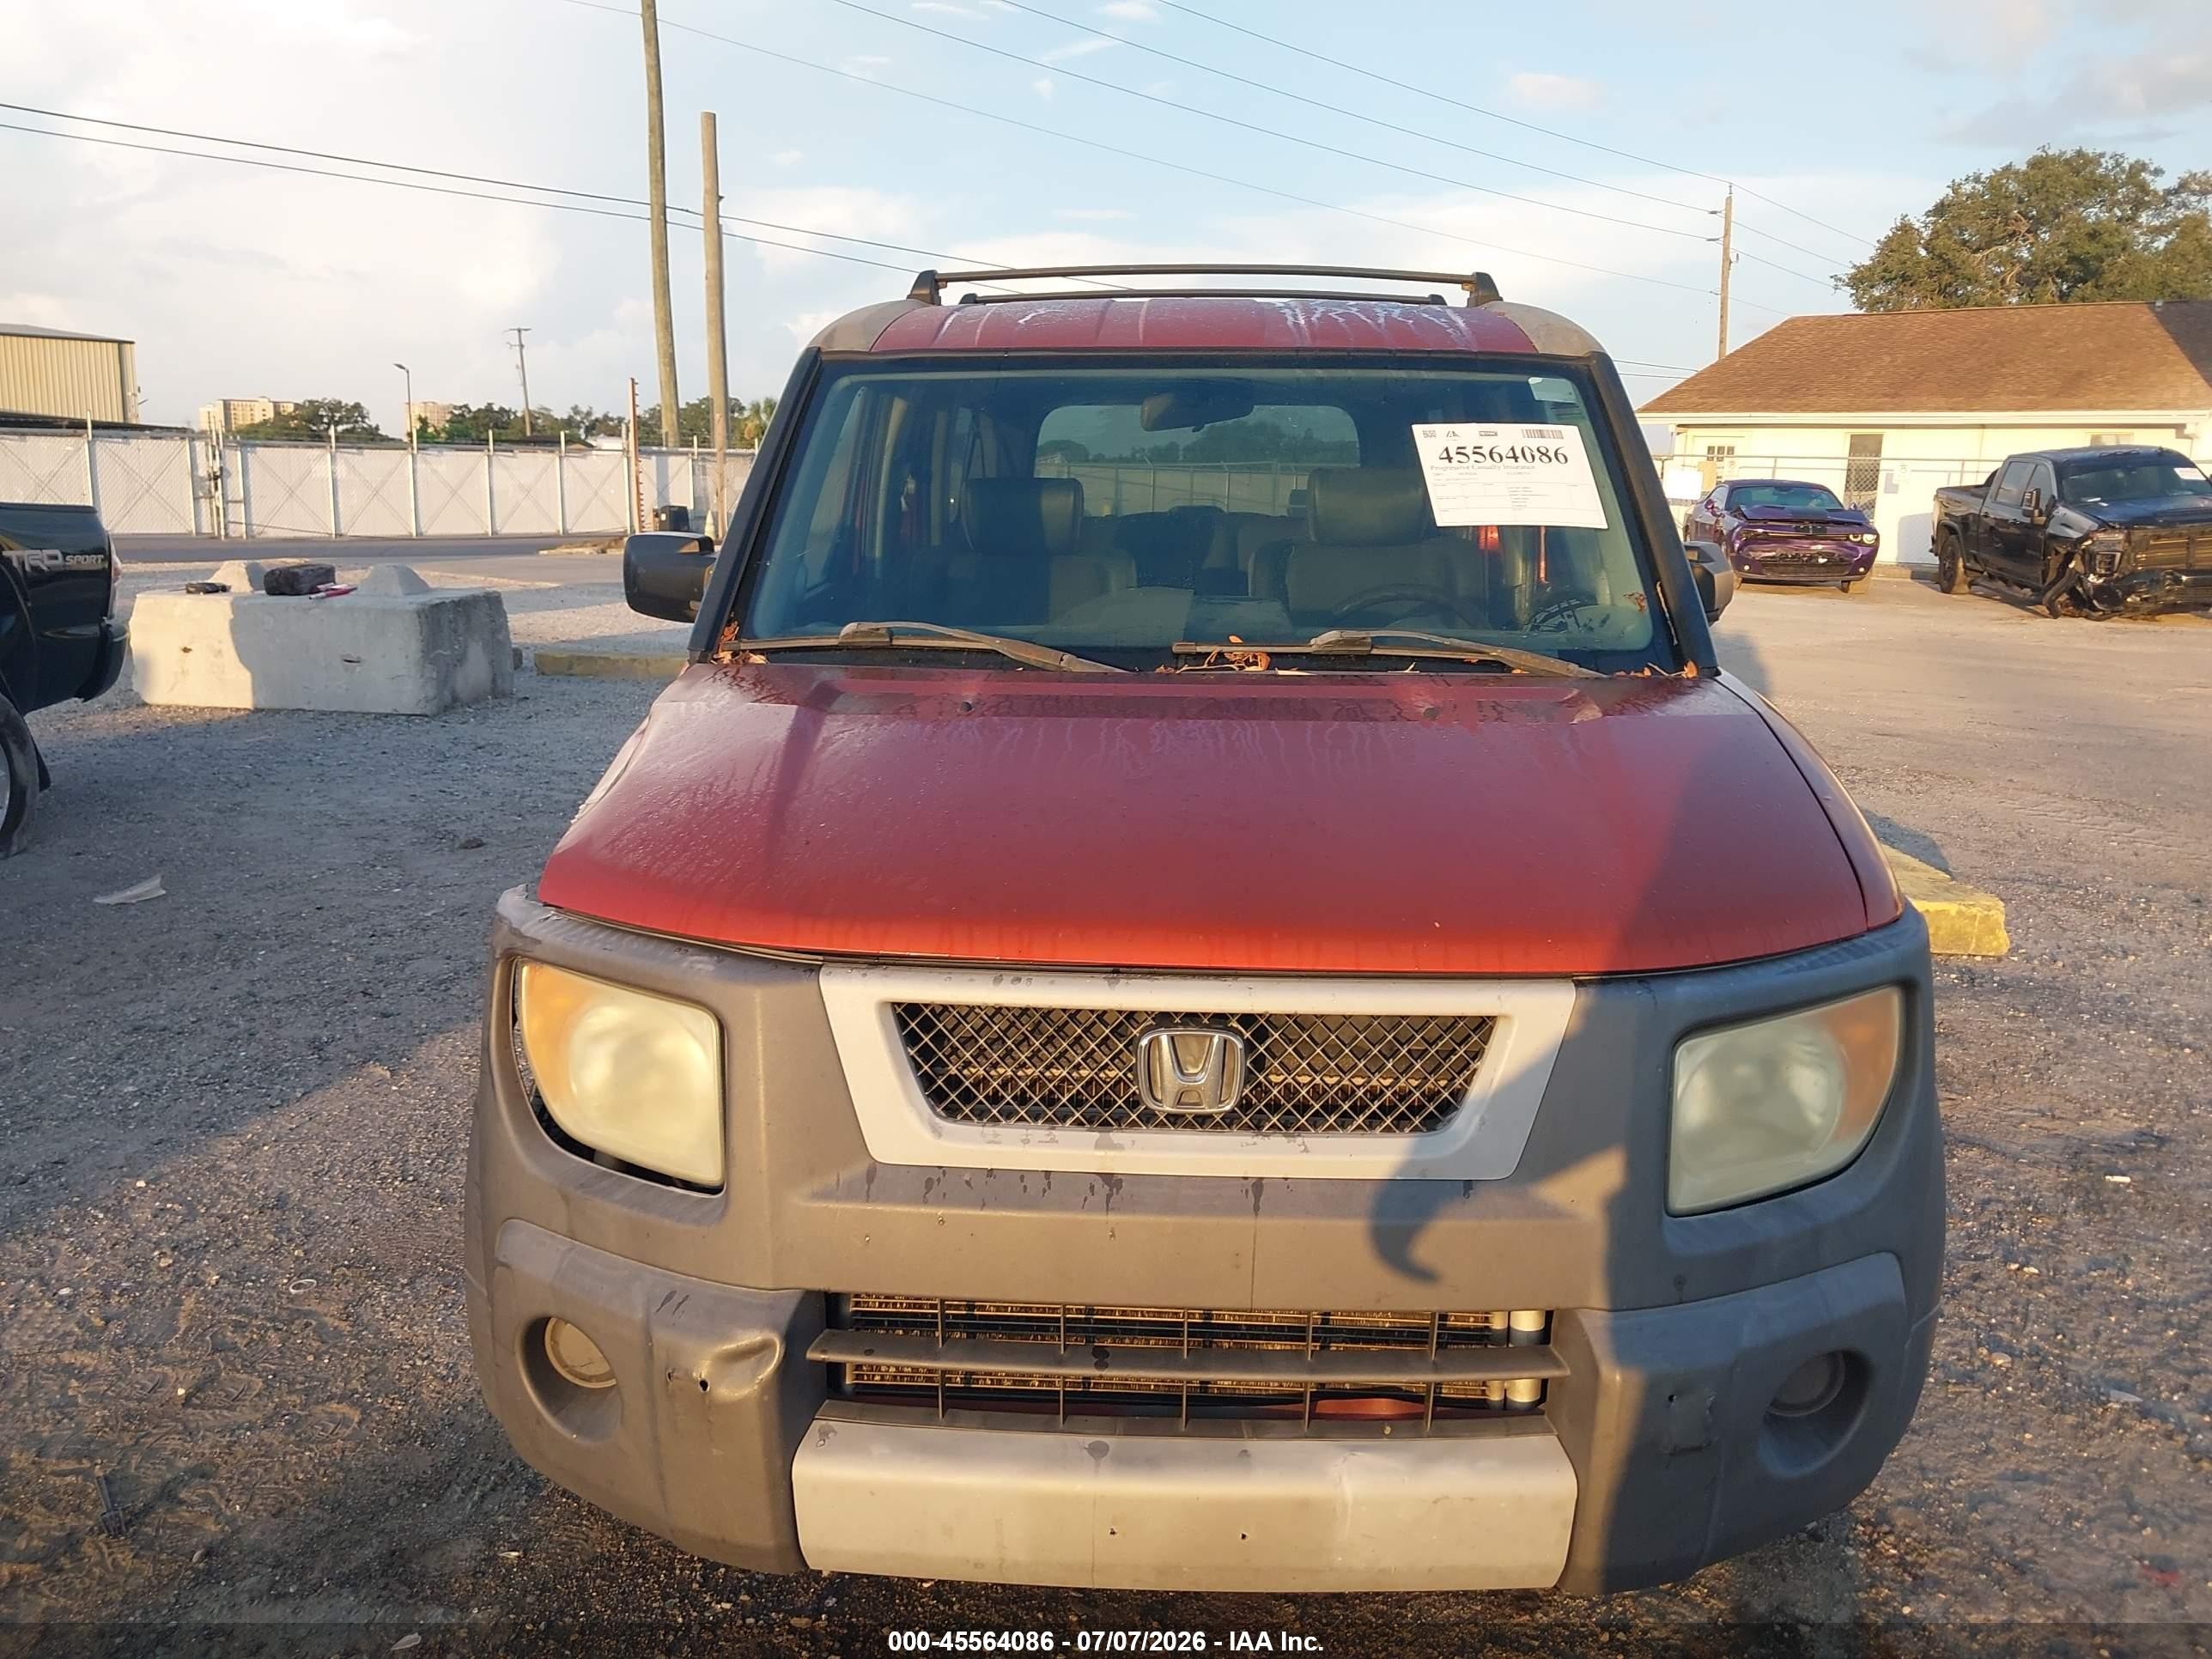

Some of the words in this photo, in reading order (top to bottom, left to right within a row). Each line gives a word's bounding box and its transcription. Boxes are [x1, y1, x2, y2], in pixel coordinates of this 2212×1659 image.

[1438, 445, 1569, 465] 45564086
[2, 549, 63, 572] TRD
[65, 555, 104, 565] SPORT
